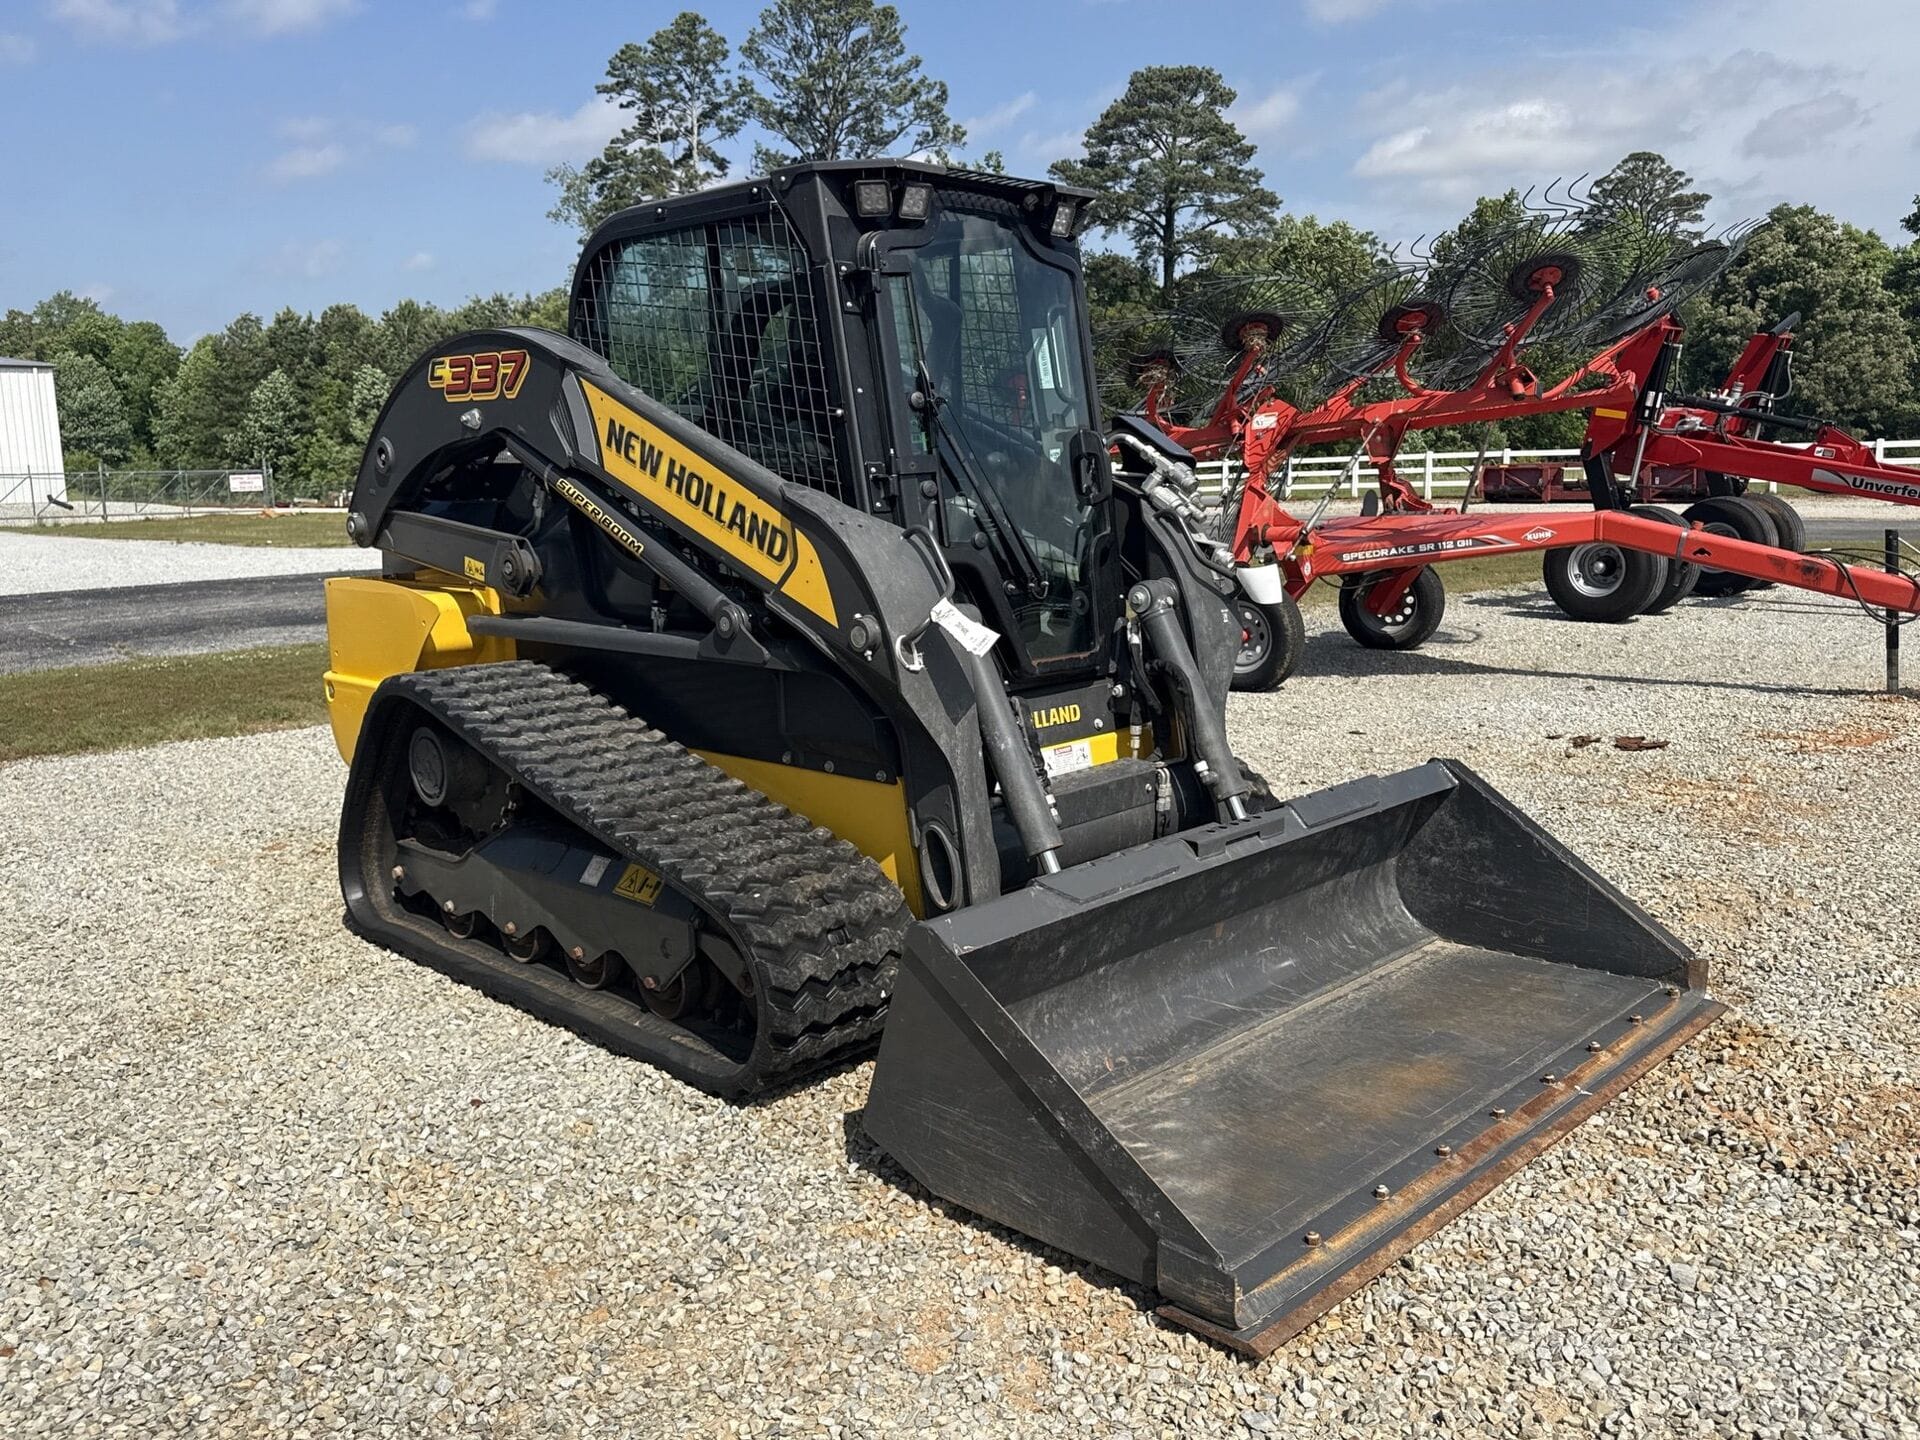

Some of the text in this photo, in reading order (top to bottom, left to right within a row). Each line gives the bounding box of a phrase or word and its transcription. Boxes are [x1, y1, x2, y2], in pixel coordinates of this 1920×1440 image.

[606, 416, 788, 564] NEW HOLLAND
[1526, 531, 1552, 541] KUHN
[1342, 545, 1415, 561] SPEEDRAKE
[1418, 542, 1435, 552] SR
[1437, 540, 1455, 550] 112
[1030, 704, 1081, 729] LLAND
